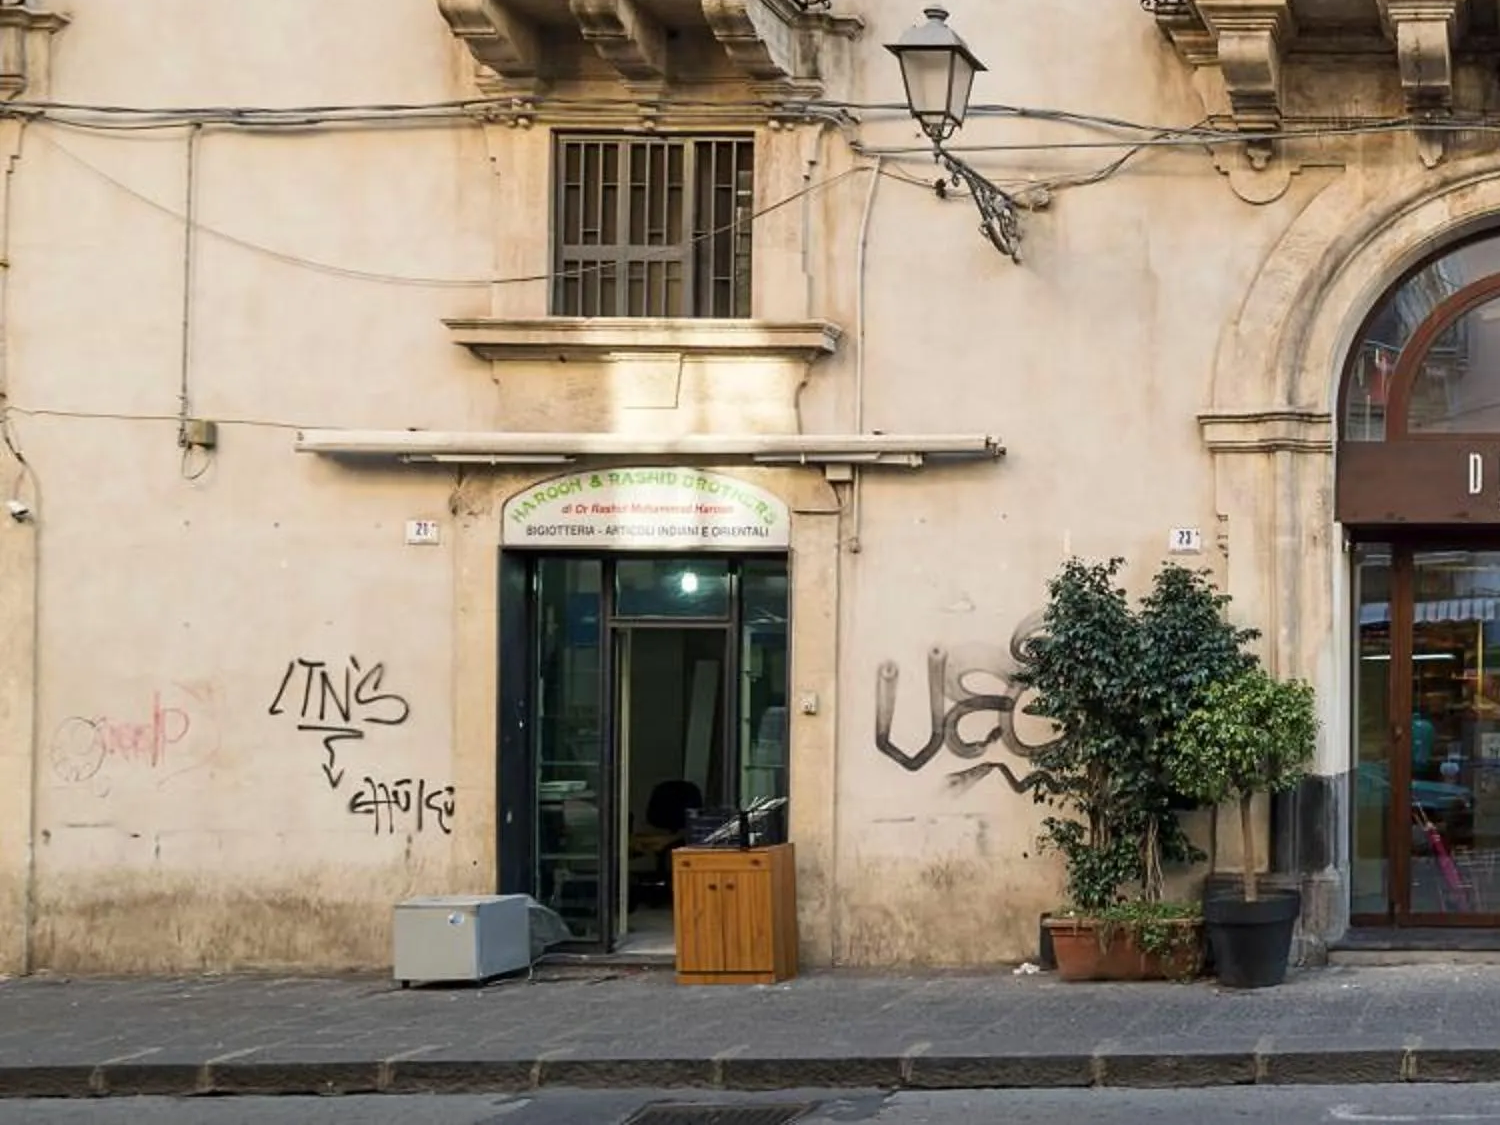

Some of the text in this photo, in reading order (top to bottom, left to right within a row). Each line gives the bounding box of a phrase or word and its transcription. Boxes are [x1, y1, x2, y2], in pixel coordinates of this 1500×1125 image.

[588, 474, 604, 488] &
[608, 471, 678, 487] RASHID
[525, 525, 595, 538] BIGIOTTERIA
[605, 525, 656, 538] ARTICOLI
[657, 525, 699, 538] INDIANI
[701, 525, 709, 538] E
[711, 525, 770, 538] ORIENTALI
